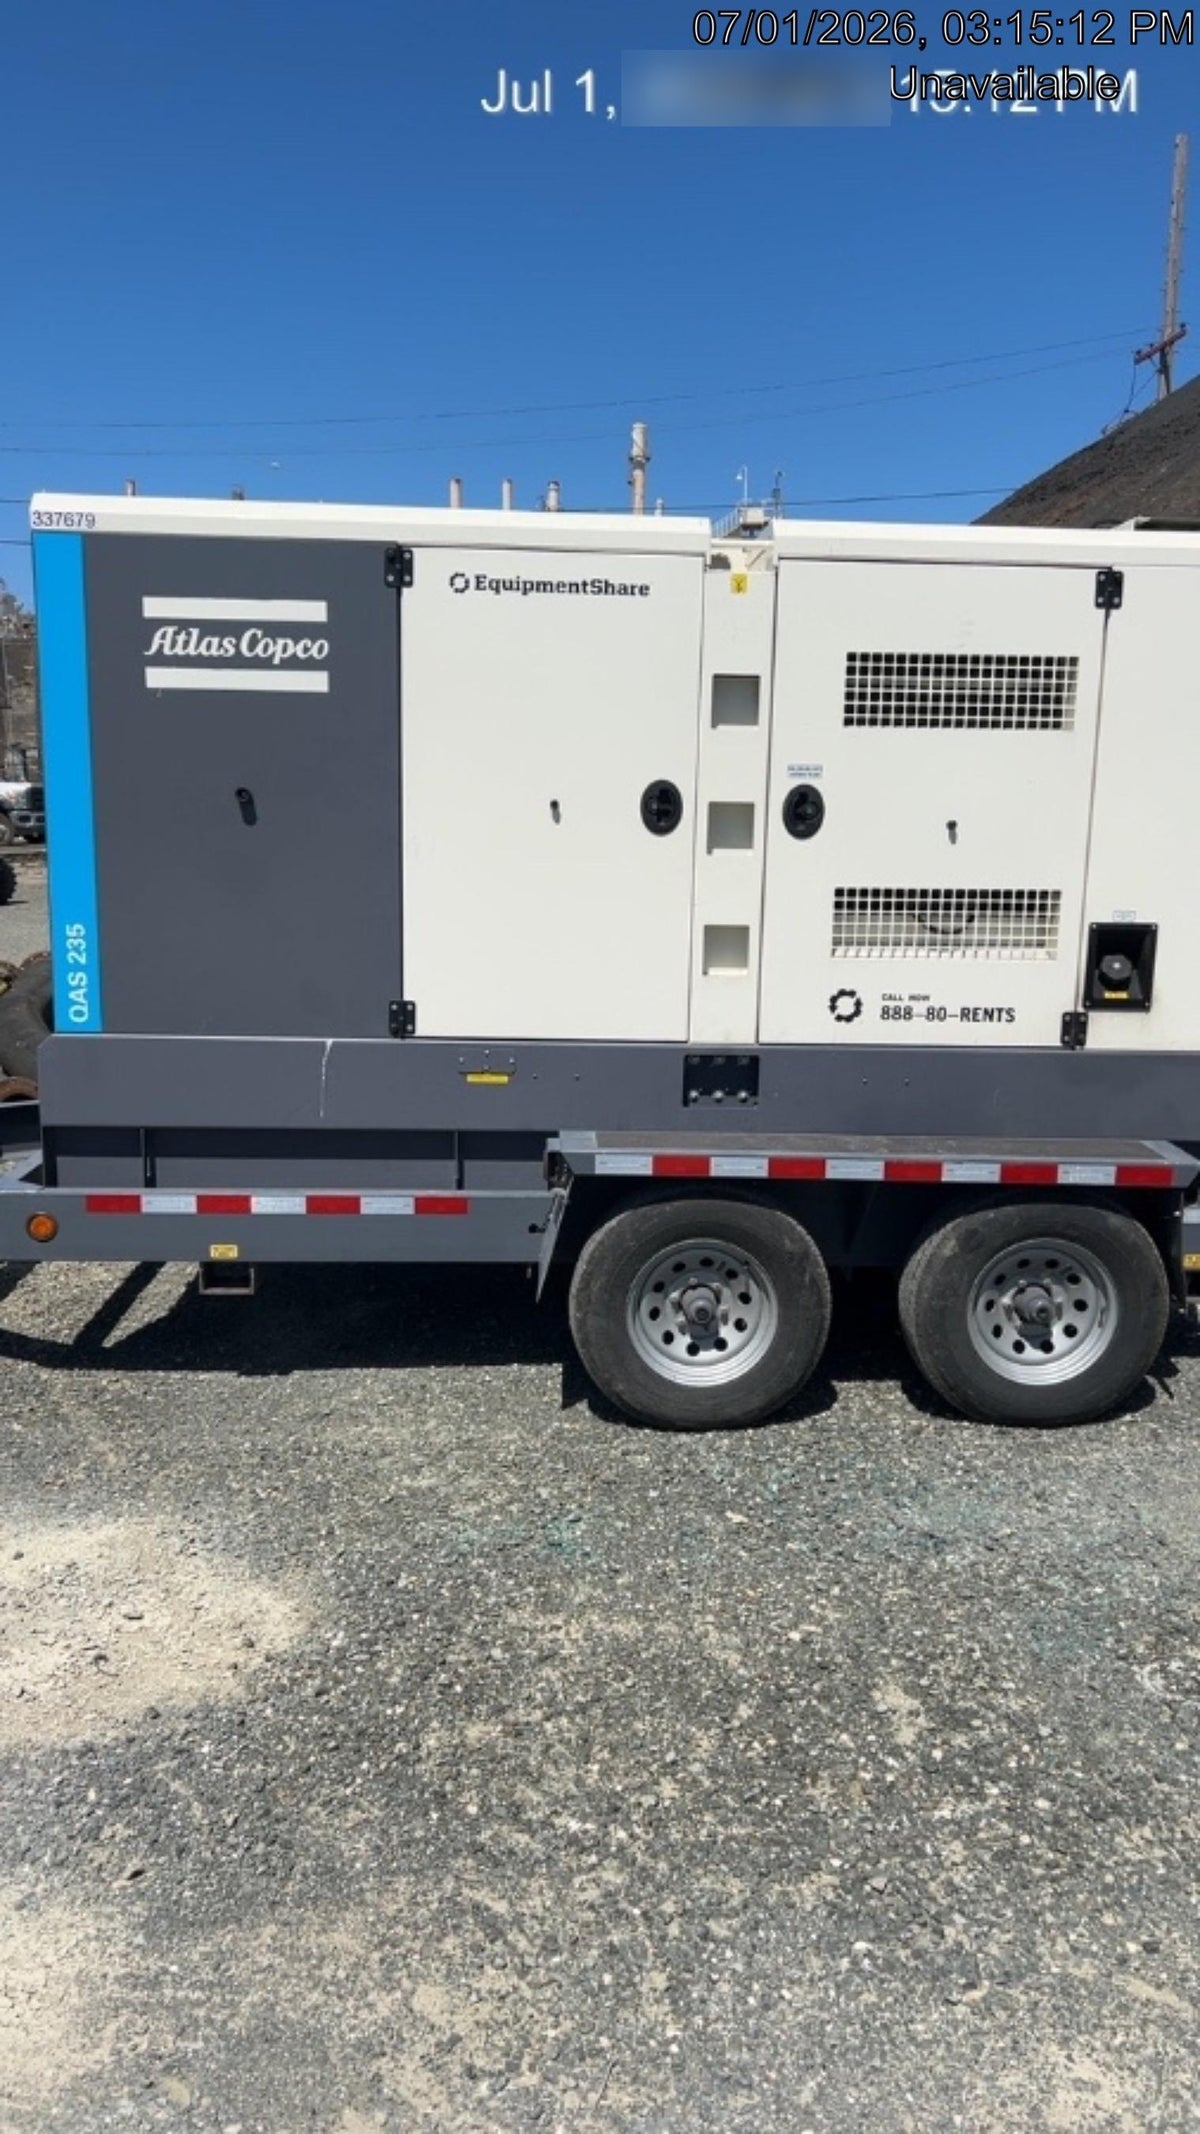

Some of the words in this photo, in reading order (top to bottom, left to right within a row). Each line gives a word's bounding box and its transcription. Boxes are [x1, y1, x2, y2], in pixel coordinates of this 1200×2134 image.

[32, 510, 97, 529] 337679
[474, 573, 650, 597] EquipmentShare
[144, 625, 238, 658] Atlas
[239, 627, 329, 665] Copco
[65, 923, 86, 965] 235
[67, 971, 88, 1023] QAS
[881, 993, 904, 1002] CALL
[908, 994, 931, 1002] NOW
[880, 1004, 1016, 1024] 888-80-RENTS
